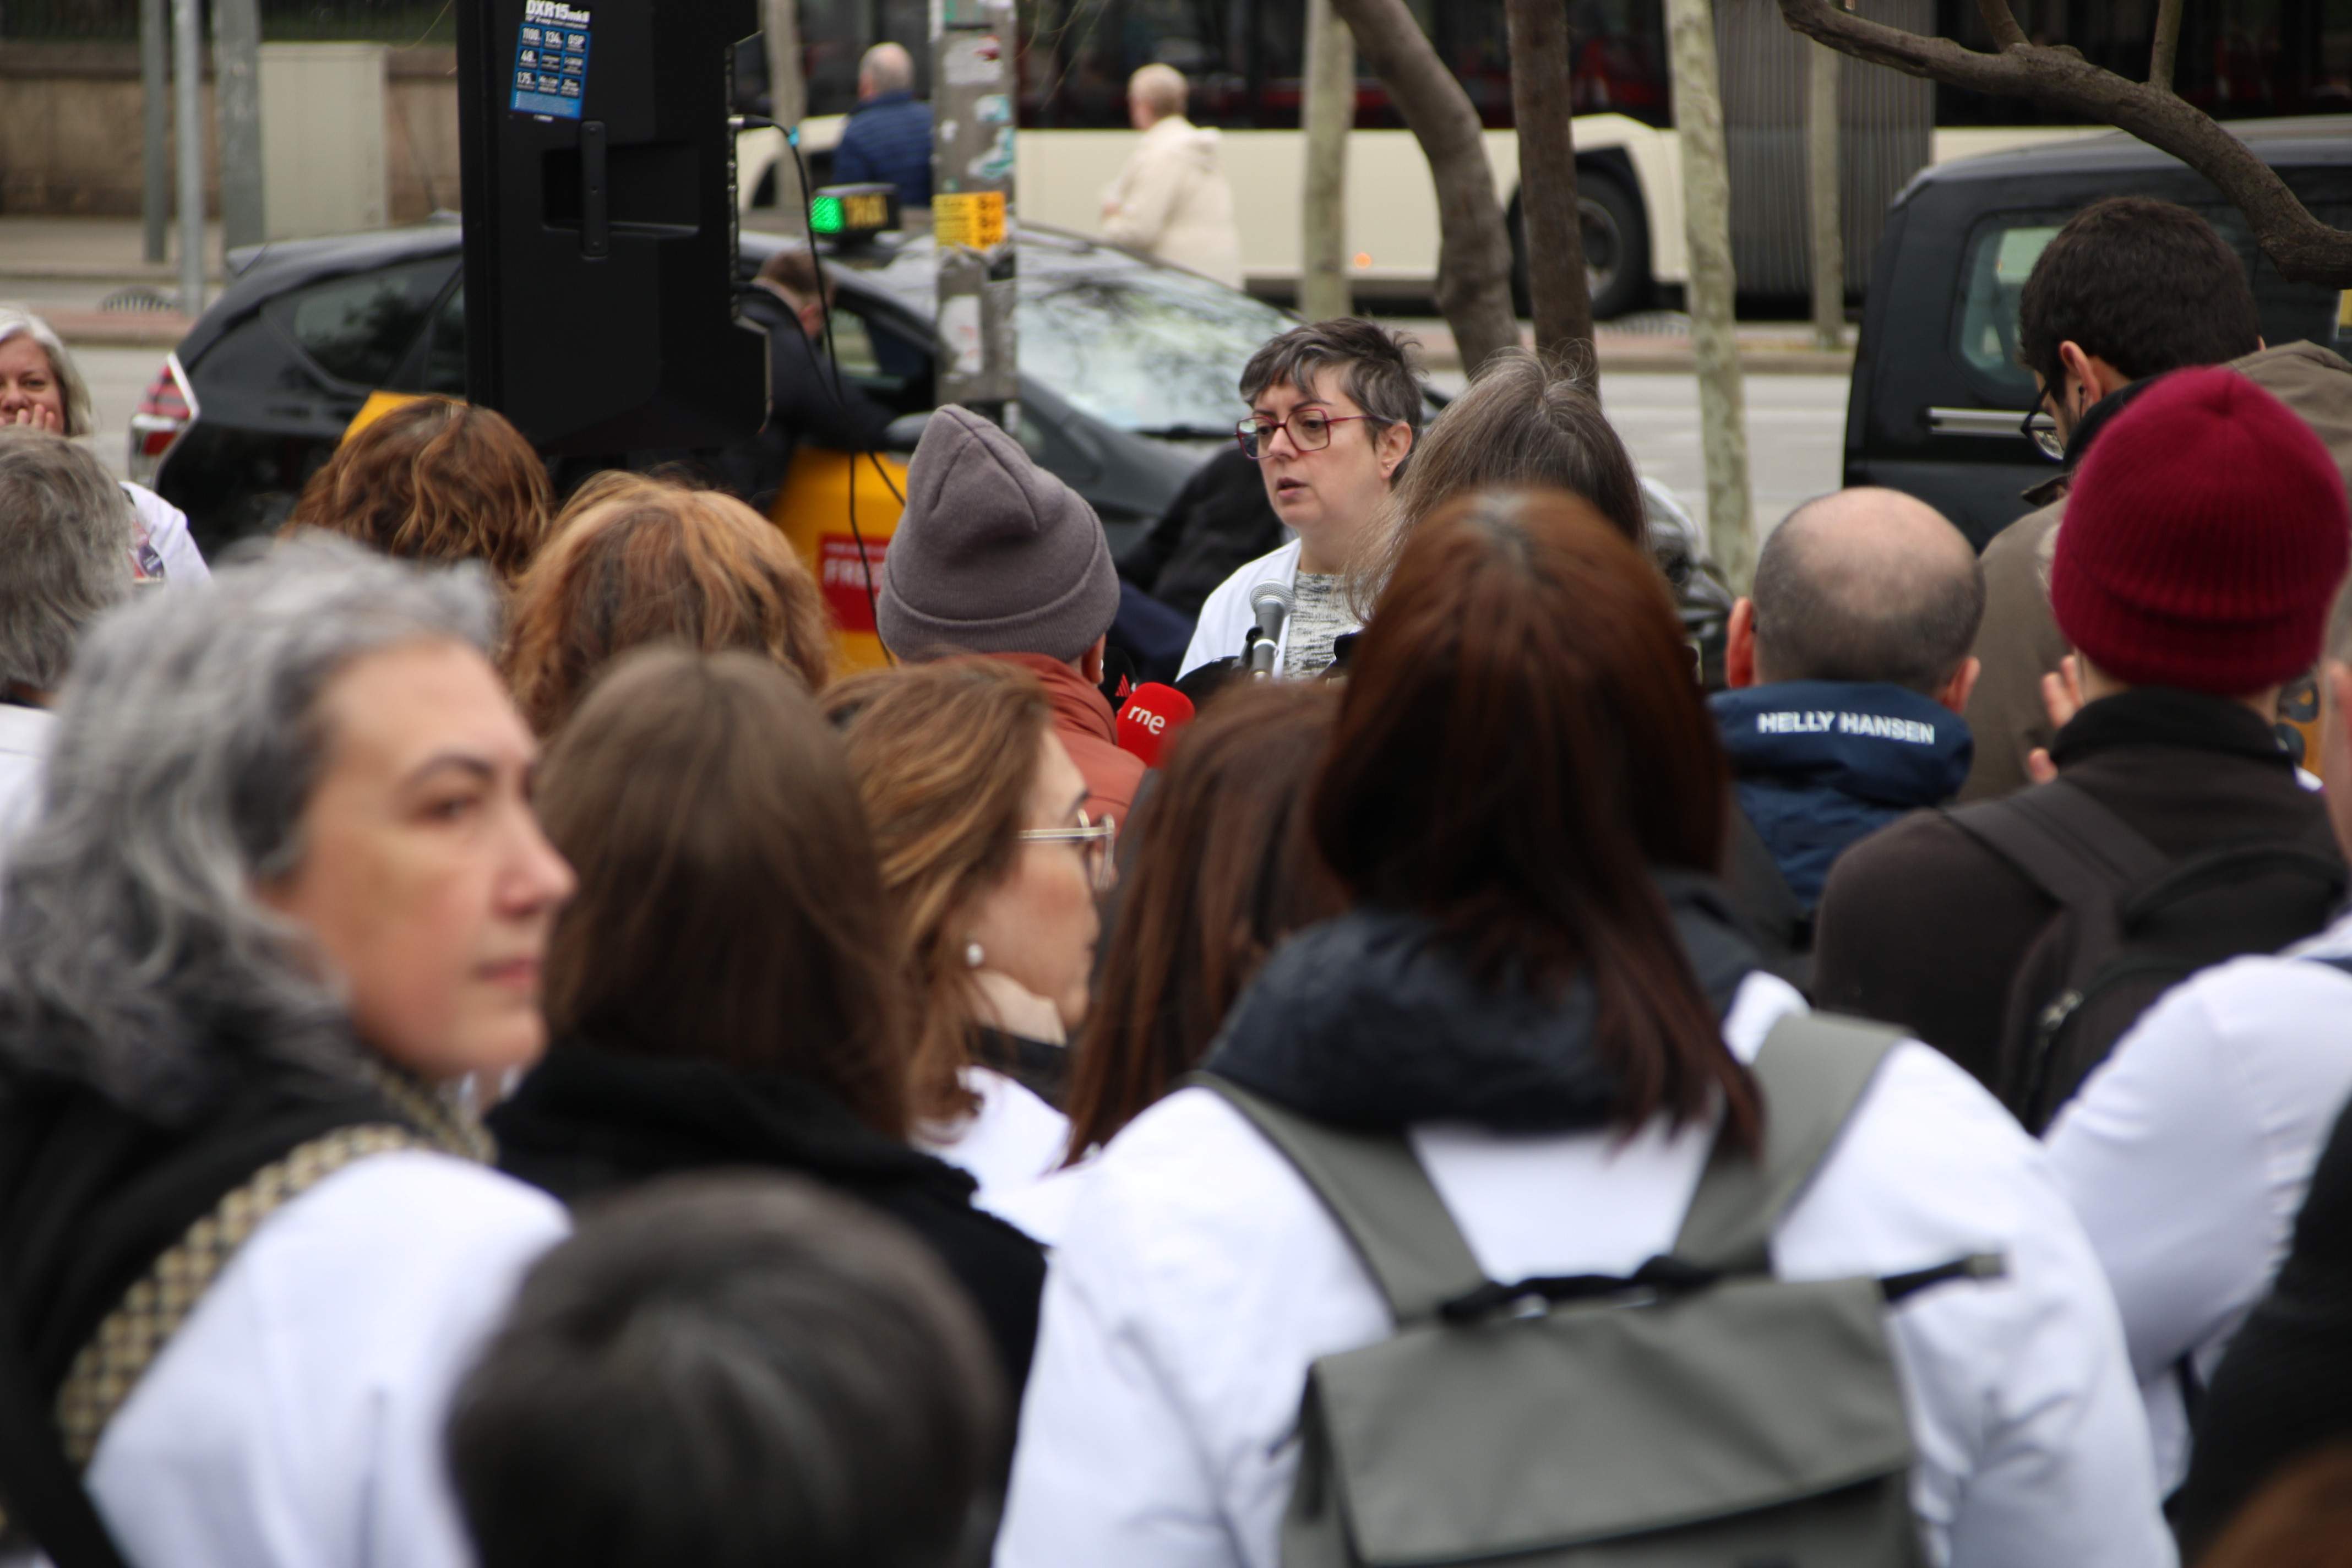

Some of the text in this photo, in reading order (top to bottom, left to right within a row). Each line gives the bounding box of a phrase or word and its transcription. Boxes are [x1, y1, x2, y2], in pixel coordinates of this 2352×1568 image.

[1128, 706, 1165, 734] rne
[1758, 711, 1935, 744] HELLY HANSEN
